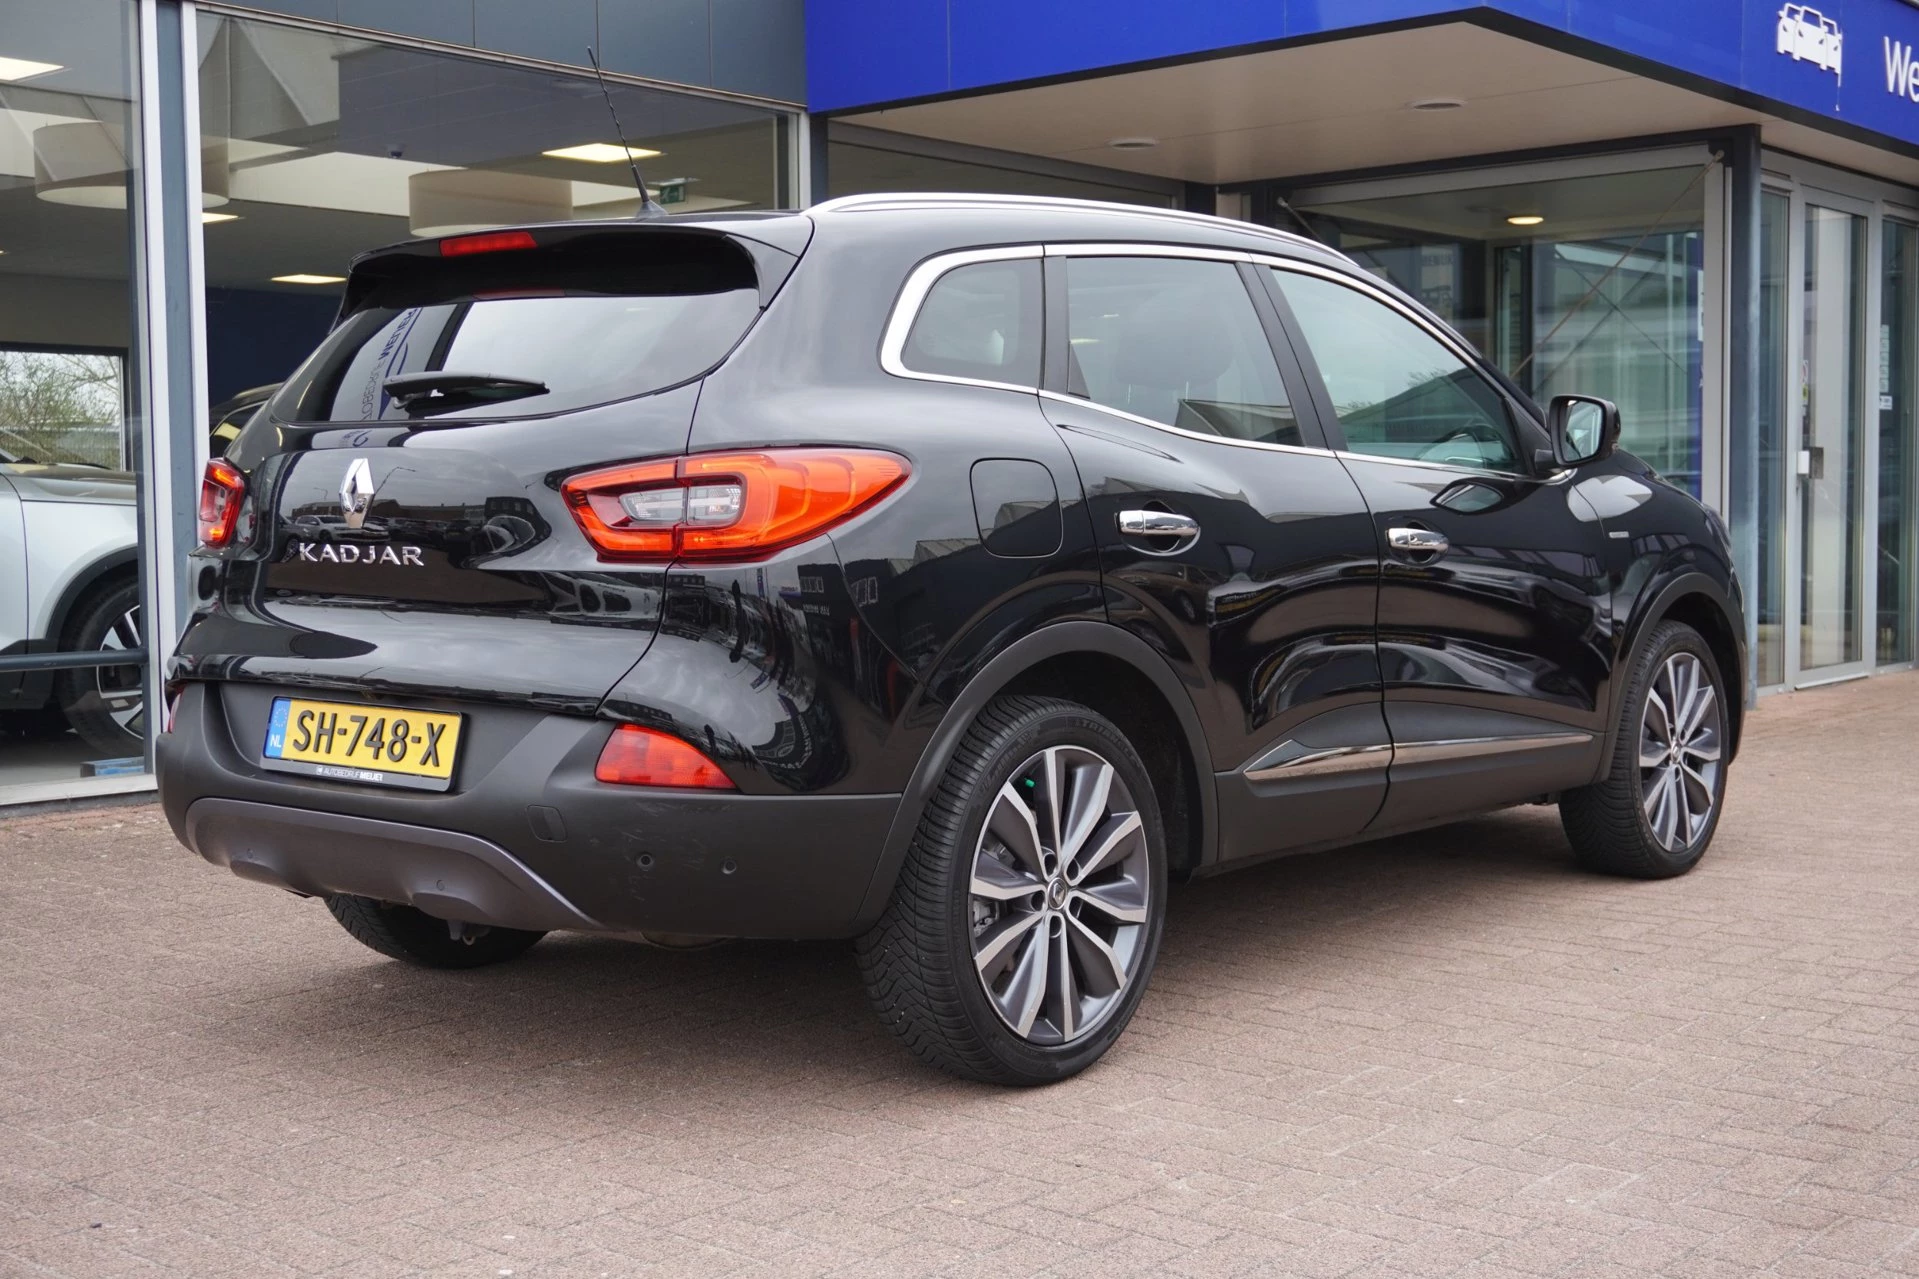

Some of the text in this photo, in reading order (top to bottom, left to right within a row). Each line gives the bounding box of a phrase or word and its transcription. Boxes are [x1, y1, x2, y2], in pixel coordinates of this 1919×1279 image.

[1884, 36, 1919, 103] We
[299, 542, 425, 567] KADJAR
[270, 734, 282, 748] NL
[292, 709, 447, 768] SH-748-X
